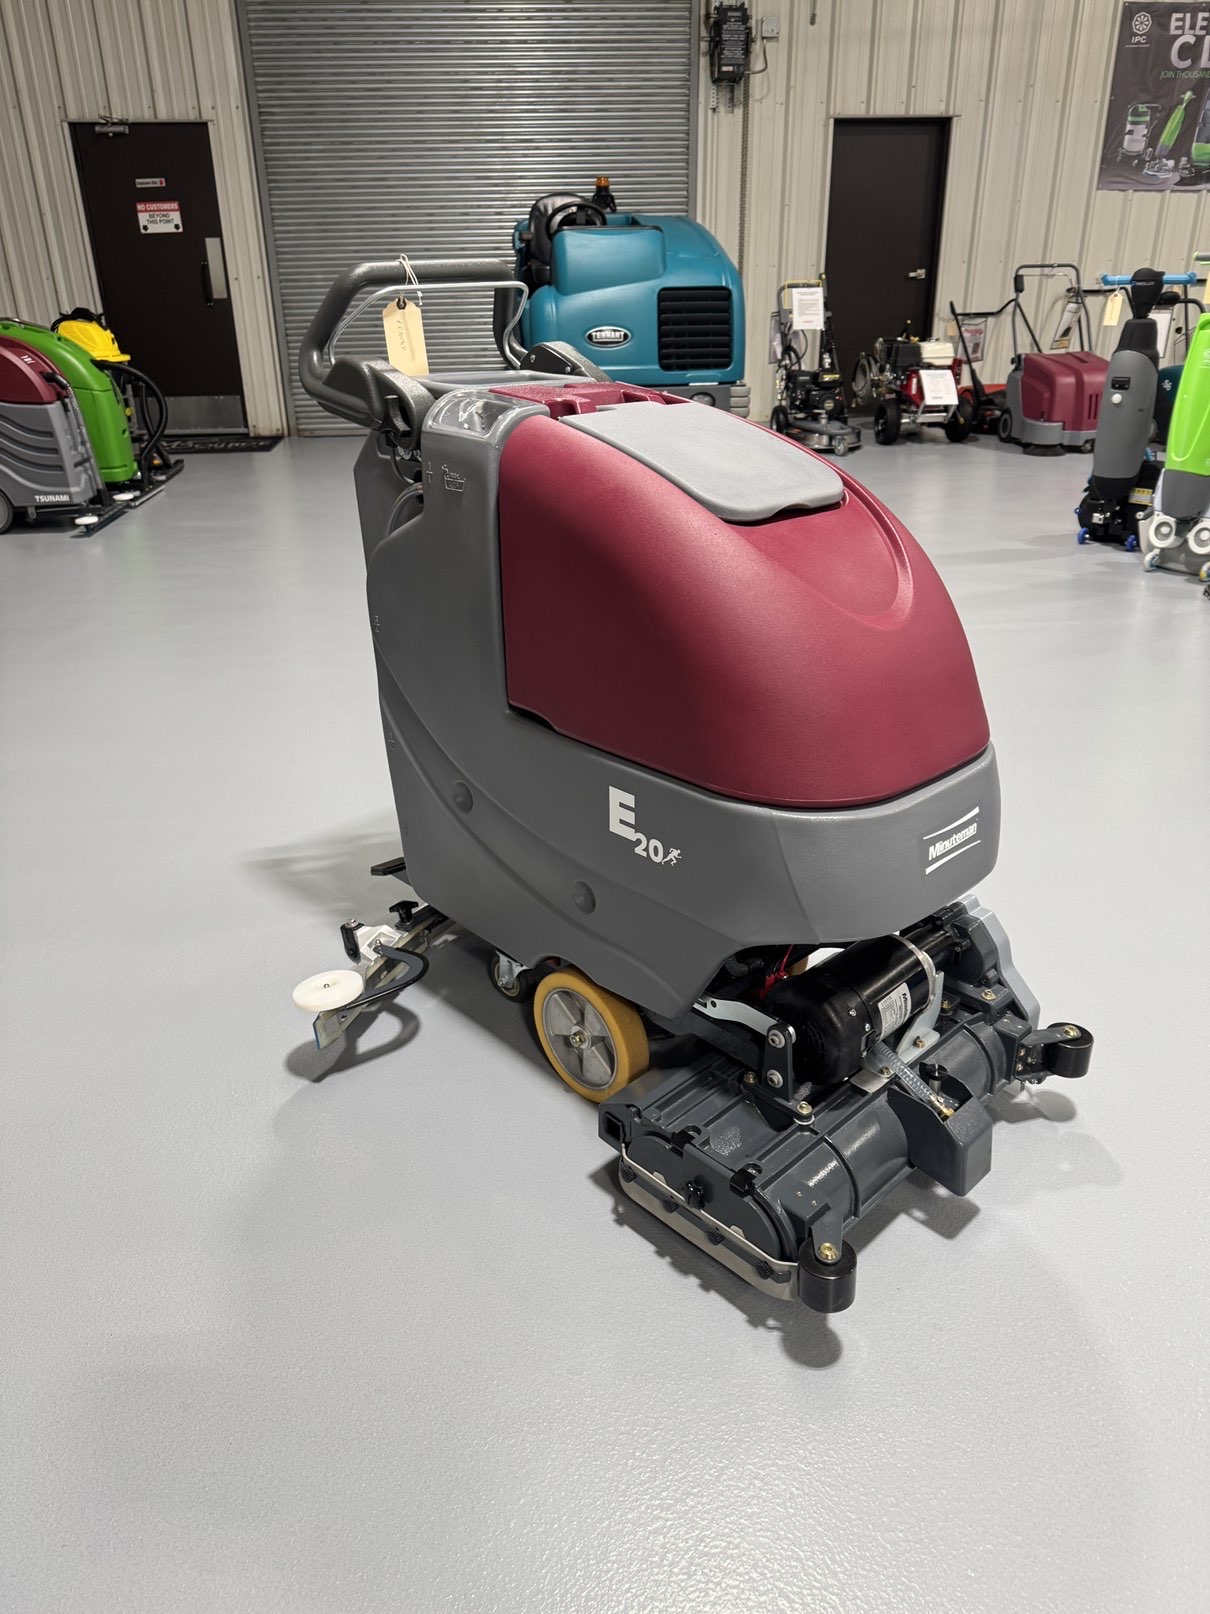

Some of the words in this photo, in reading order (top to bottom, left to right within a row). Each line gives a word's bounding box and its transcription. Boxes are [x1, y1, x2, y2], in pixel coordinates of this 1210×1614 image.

[1160, 70, 1175, 80] JOIN
[591, 331, 625, 341] TENNANT
[35, 494, 70, 502] TSUNAMI
[928, 822, 978, 861] Minuteman
